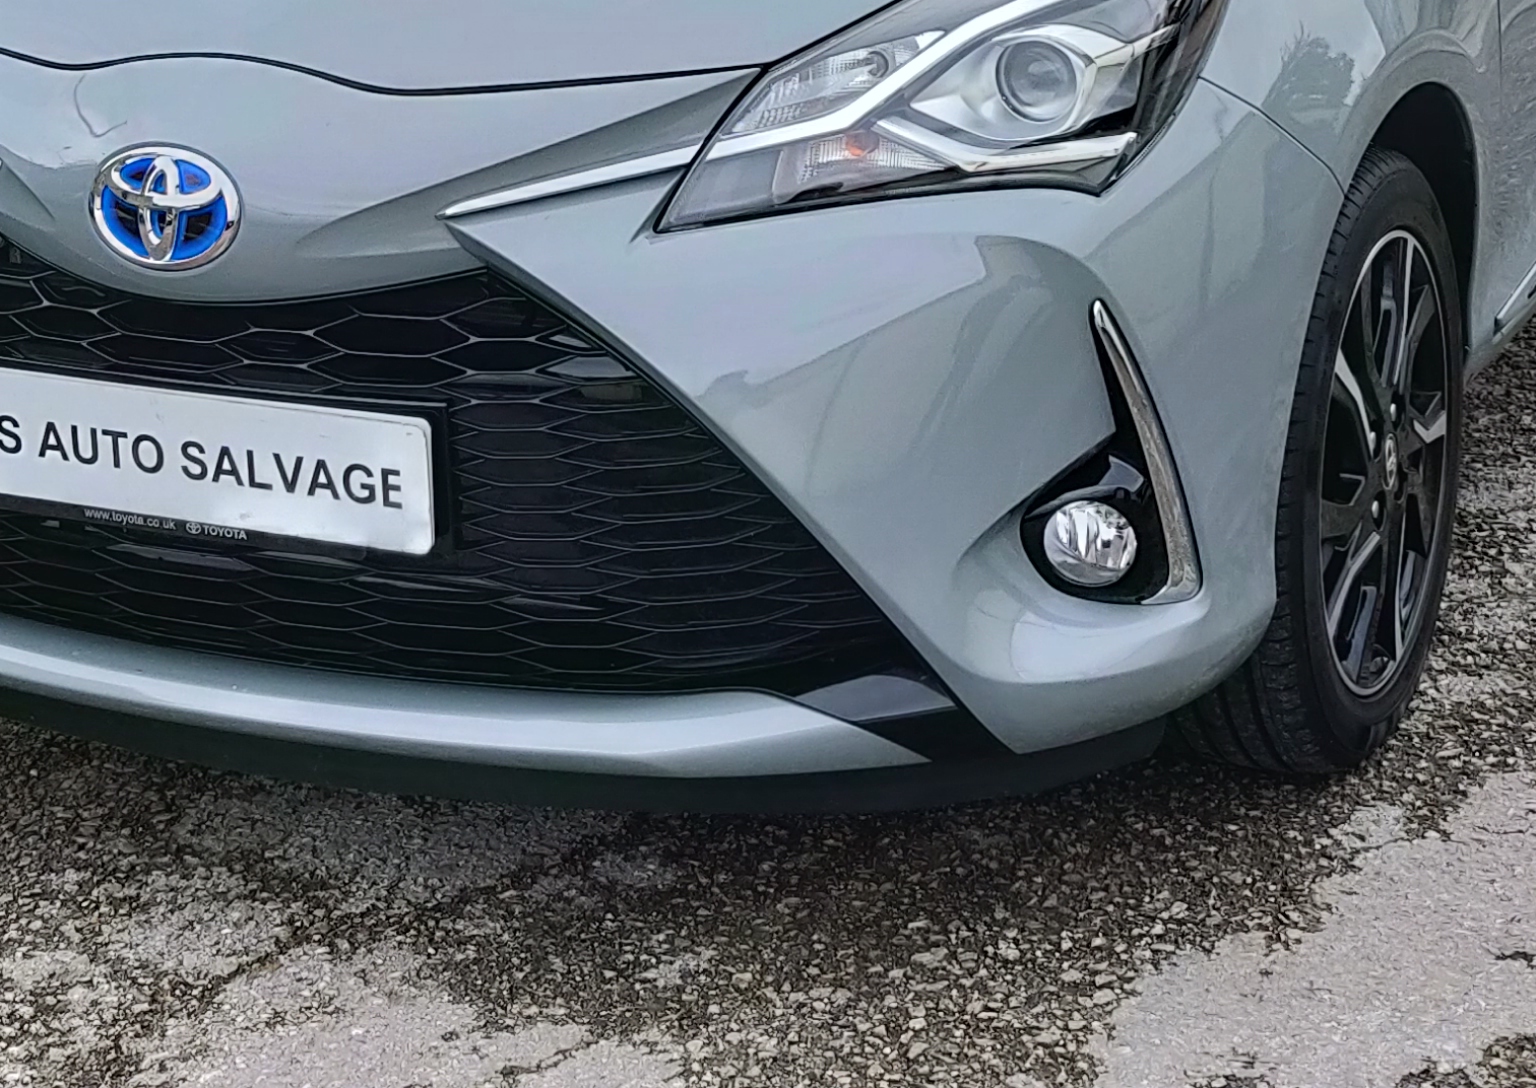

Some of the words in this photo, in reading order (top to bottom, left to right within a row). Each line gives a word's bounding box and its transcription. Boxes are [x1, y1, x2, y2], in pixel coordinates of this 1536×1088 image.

[39, 421, 164, 474] AUTO
[180, 441, 404, 510] SALVAGE
[84, 509, 176, 531] www.toyota.co.uk
[203, 525, 247, 541] TOYOTA
